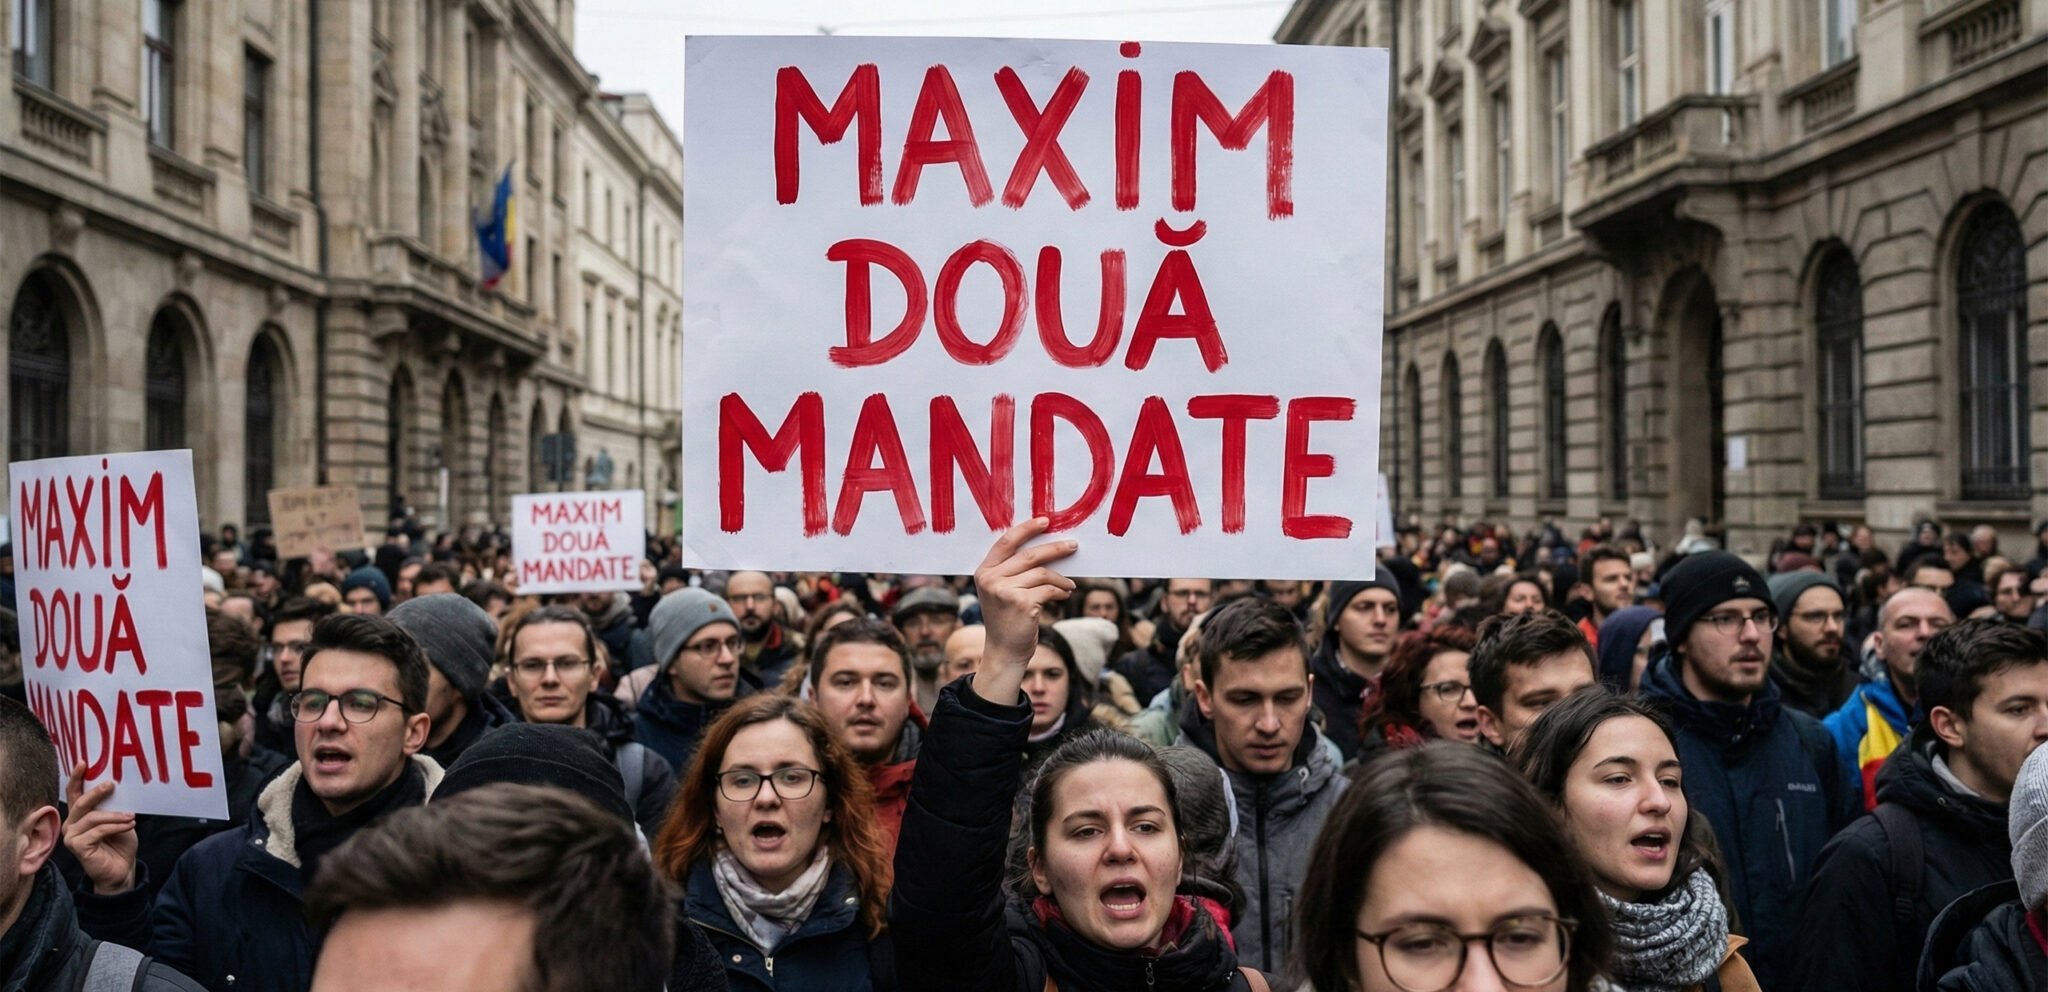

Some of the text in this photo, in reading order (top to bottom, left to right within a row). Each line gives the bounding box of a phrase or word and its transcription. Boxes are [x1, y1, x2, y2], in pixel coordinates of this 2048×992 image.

[826, 218, 1229, 372] DOUĂ
[532, 499, 621, 525] MAXIM
[719, 391, 1356, 540] MANDATE
[524, 556, 635, 583] MANDATE
[30, 573, 147, 675] DOUĂ
